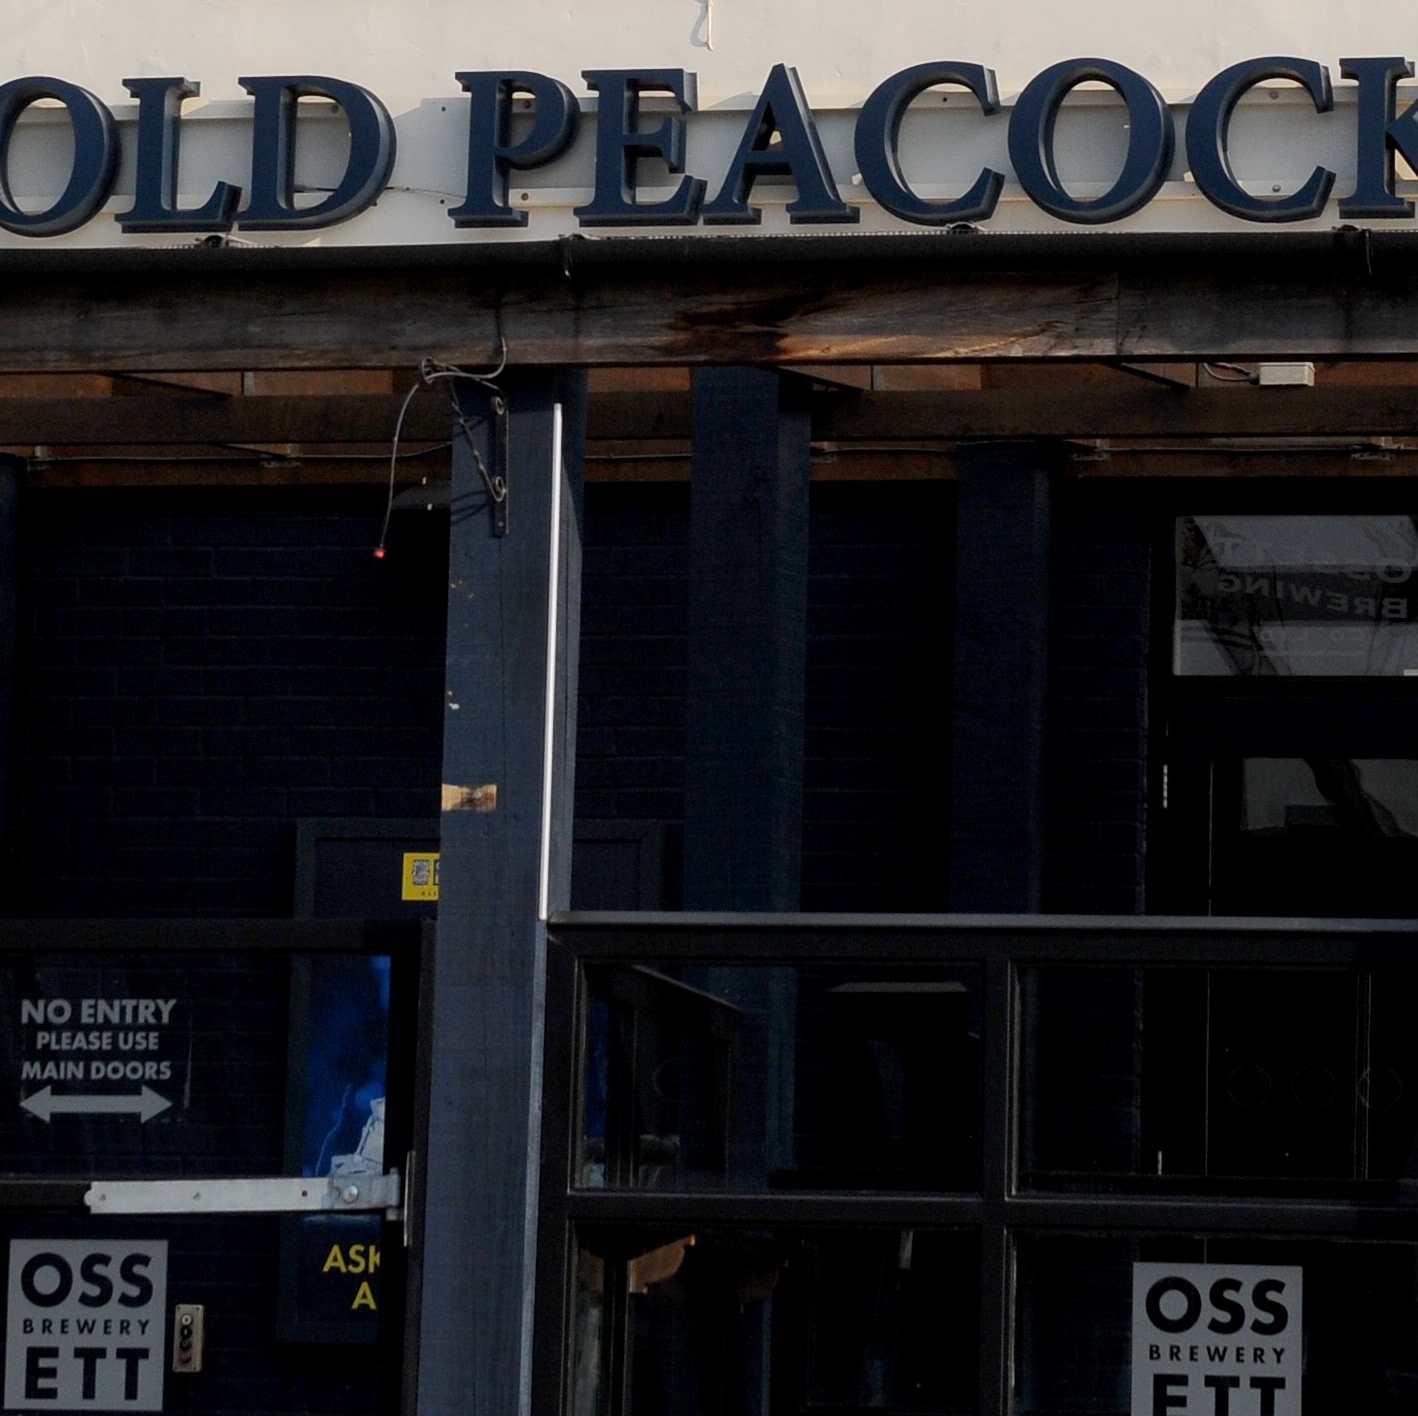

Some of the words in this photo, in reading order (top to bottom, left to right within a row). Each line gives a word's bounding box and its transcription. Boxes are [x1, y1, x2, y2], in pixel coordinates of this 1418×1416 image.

[21, 998, 72, 1024] NO
[82, 998, 177, 1024] ENTRY
[36, 1031, 112, 1050] PLEASE
[118, 1031, 159, 1050] USE
[21, 1061, 84, 1080] MAIN
[90, 1061, 172, 1080] DOORS
[21, 1252, 153, 1308] OSS
[1145, 1276, 1289, 1336] OSS
[23, 1318, 150, 1335] BREWERY
[1149, 1344, 1285, 1364] BREWERY
[25, 1347, 150, 1400] ETT
